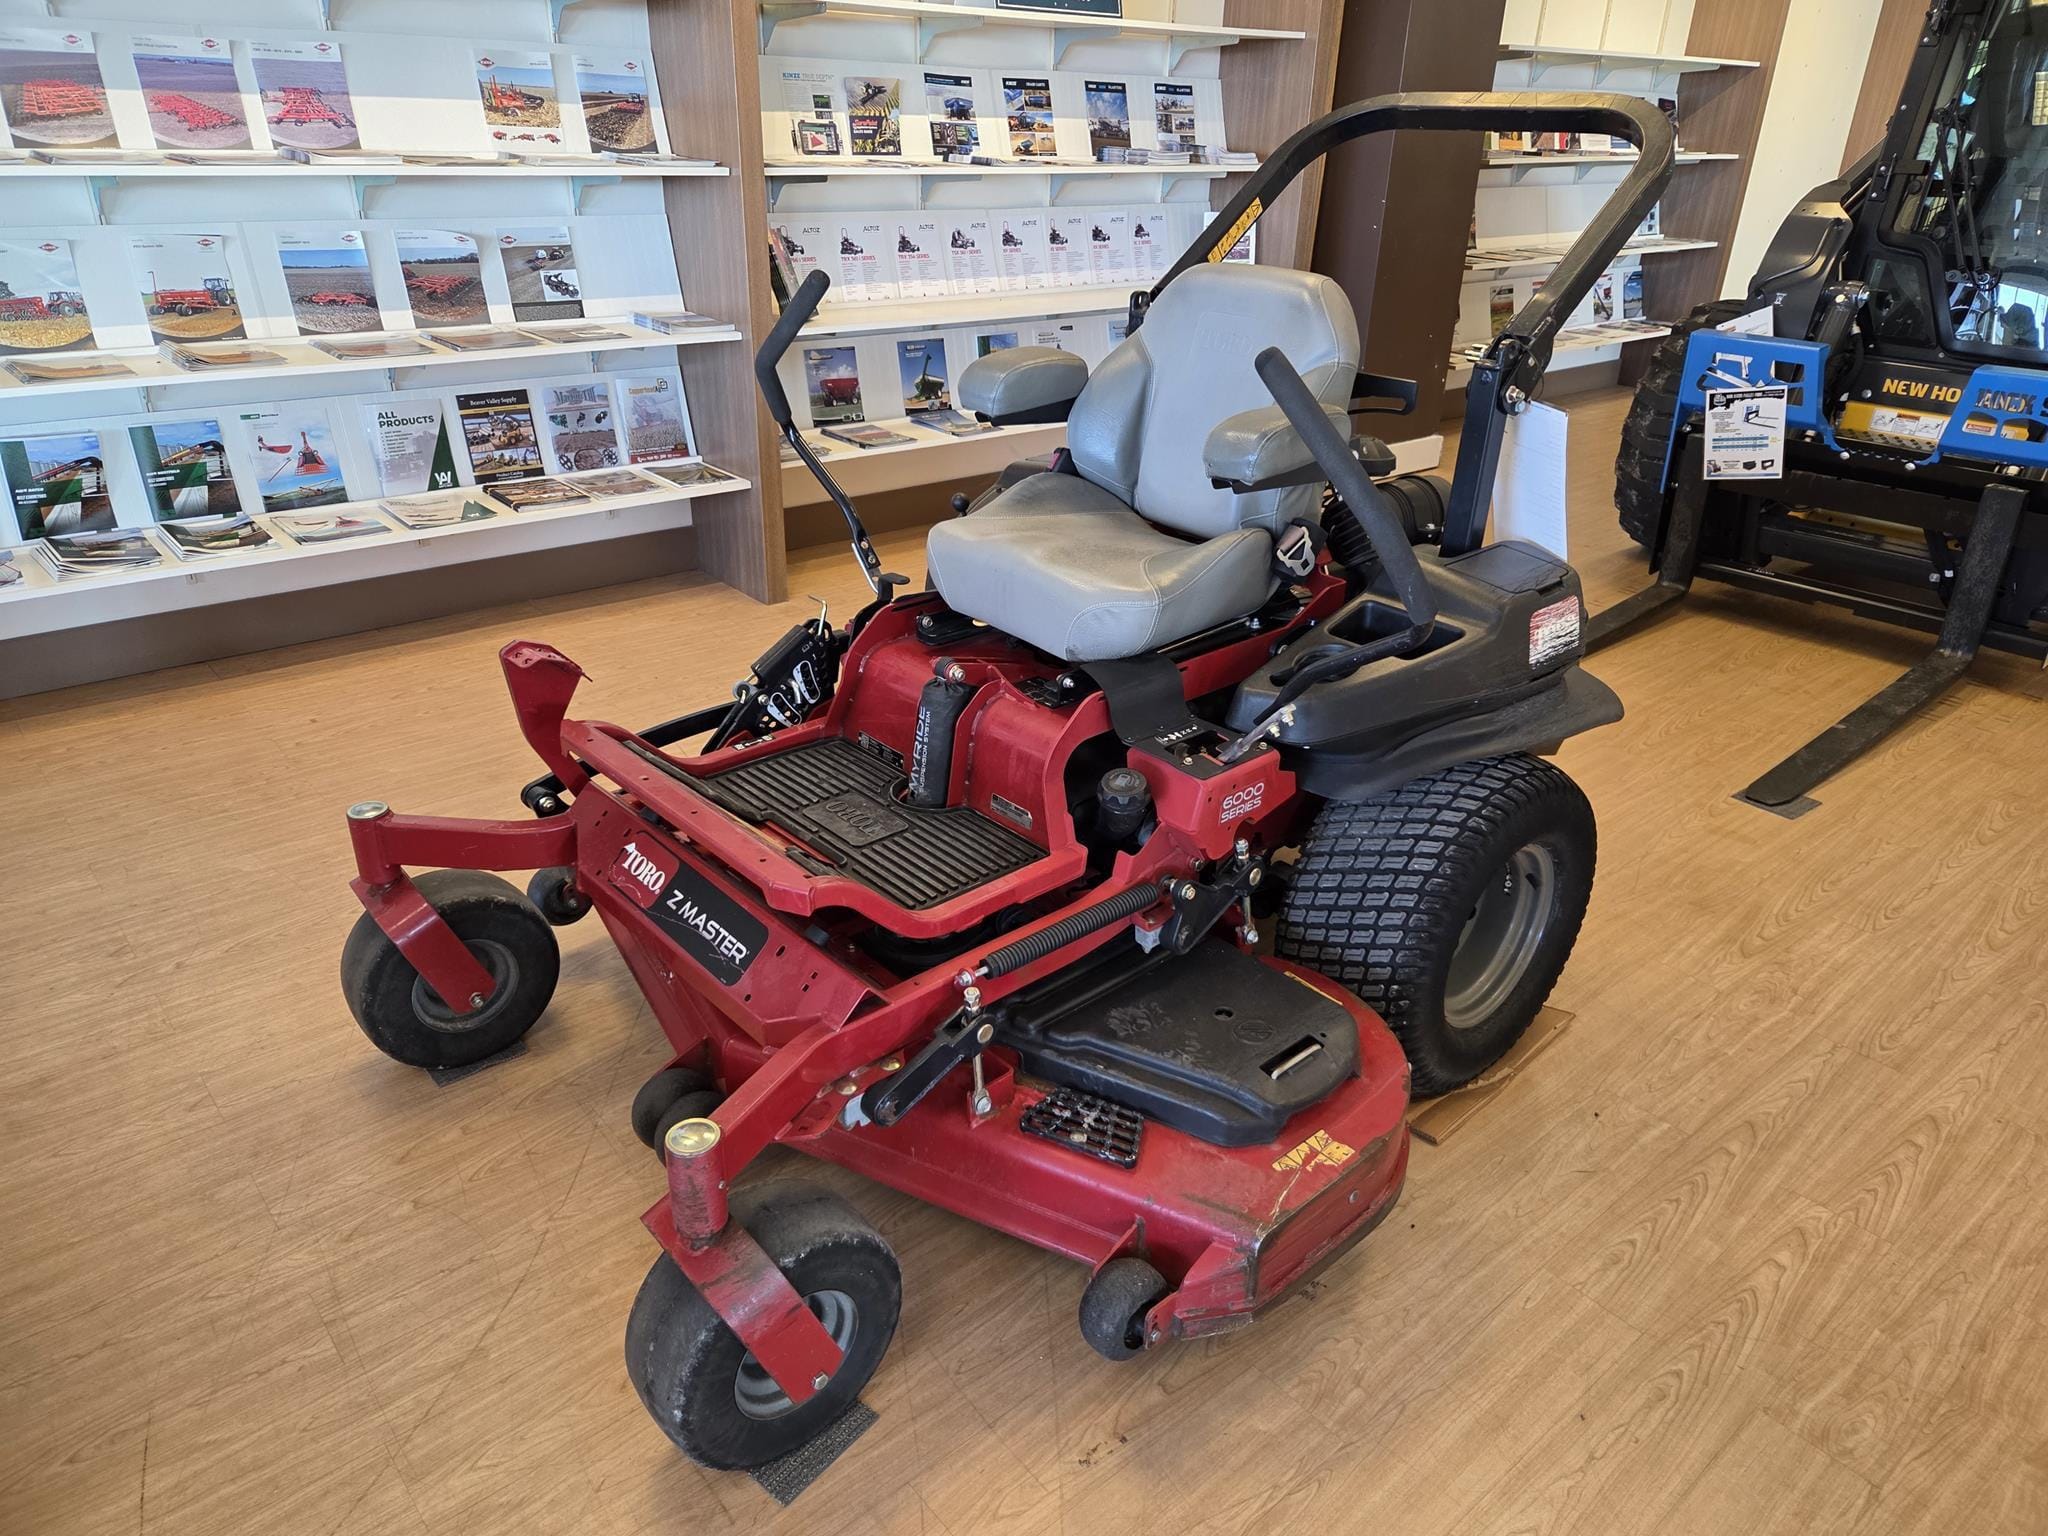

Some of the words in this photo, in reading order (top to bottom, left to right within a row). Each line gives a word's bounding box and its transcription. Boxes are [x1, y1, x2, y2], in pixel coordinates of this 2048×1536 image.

[501, 396, 517, 404] Supply
[1882, 378, 1929, 398] NEW
[377, 411, 398, 420] ALL
[378, 415, 435, 429] PRODUCTS
[923, 711, 932, 743] SYSTEM
[908, 705, 926, 794] MYRIDE
[920, 744, 928, 793] SUSPENSION
[1219, 796, 1262, 824] SERIES
[1222, 782, 1265, 810] 6000
[622, 842, 665, 894] TORO
[666, 889, 685, 911] Z
[677, 900, 748, 966] MASTER
